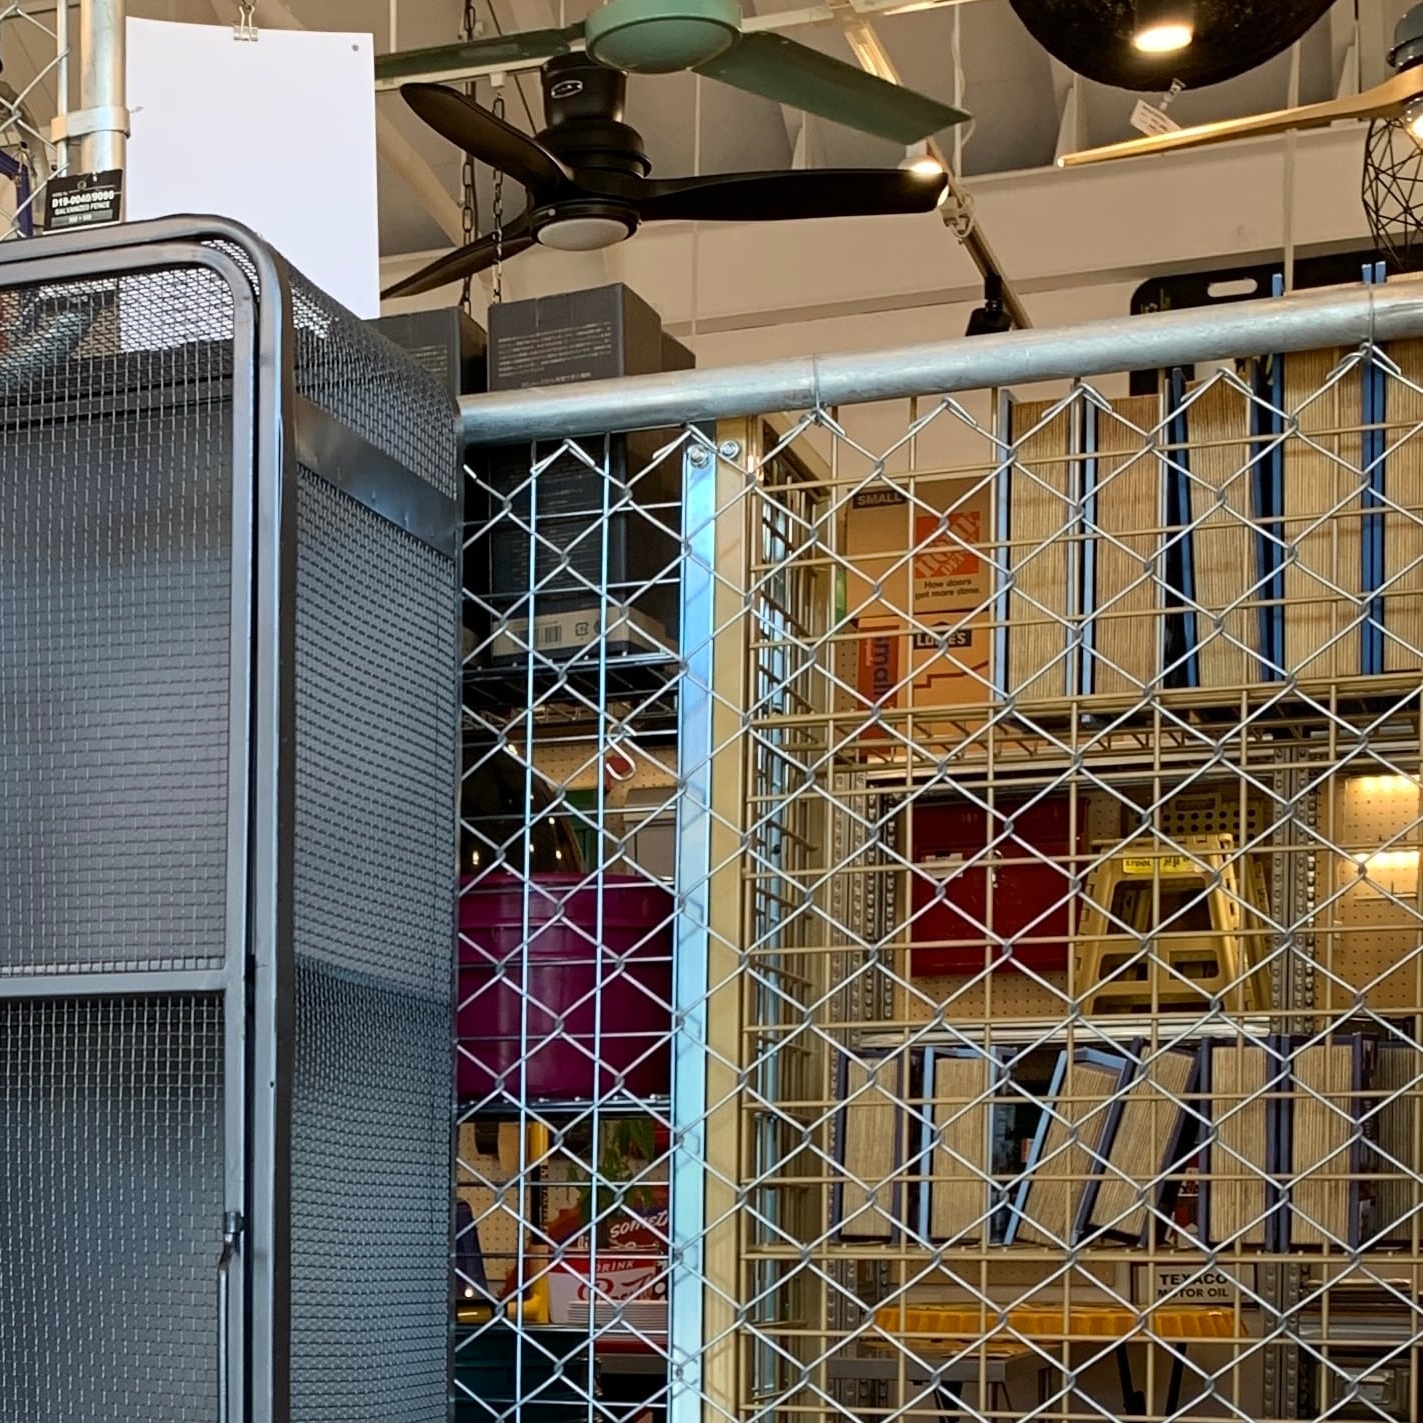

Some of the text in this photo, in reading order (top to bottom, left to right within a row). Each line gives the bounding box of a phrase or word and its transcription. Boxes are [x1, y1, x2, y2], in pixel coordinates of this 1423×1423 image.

[857, 490, 903, 506] SMALL
[924, 576, 973, 589] How doers
[931, 588, 955, 598] more
[916, 631, 967, 648] LOE'S
[1159, 1273, 1229, 1286] TEXACO
[1207, 1287, 1229, 1298] OIL
